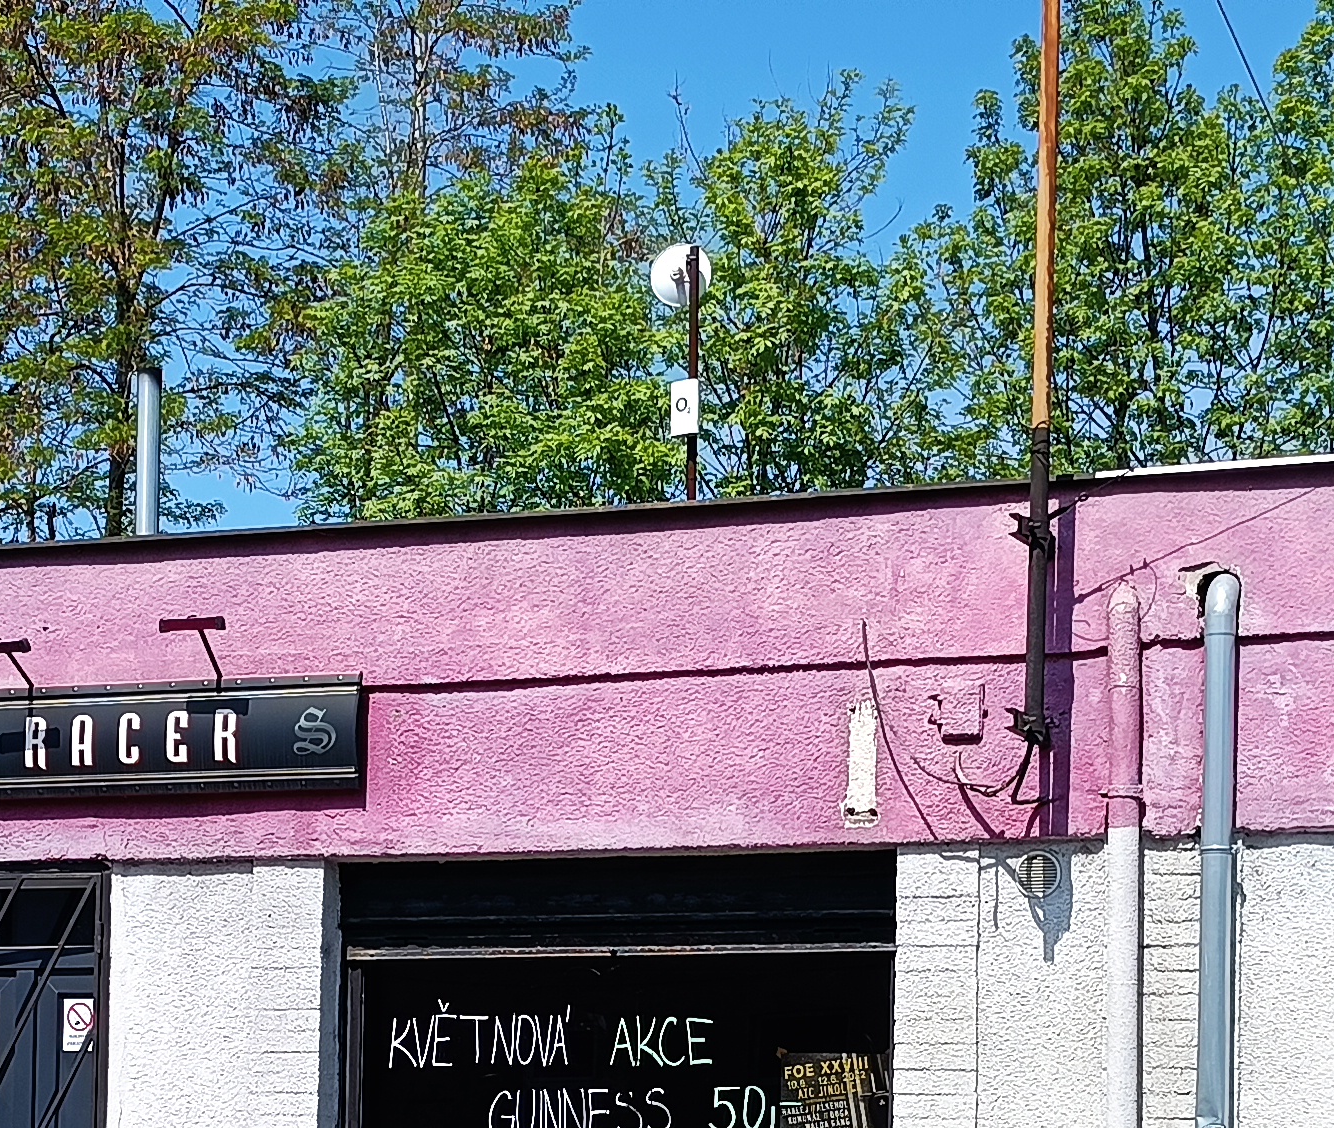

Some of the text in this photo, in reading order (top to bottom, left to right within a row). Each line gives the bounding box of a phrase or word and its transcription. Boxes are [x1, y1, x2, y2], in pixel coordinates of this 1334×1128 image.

[24, 708, 238, 772] RACER
[388, 998, 714, 1069] KVĚTNOVÁ AKCE
[784, 1063, 815, 1079] FOE
